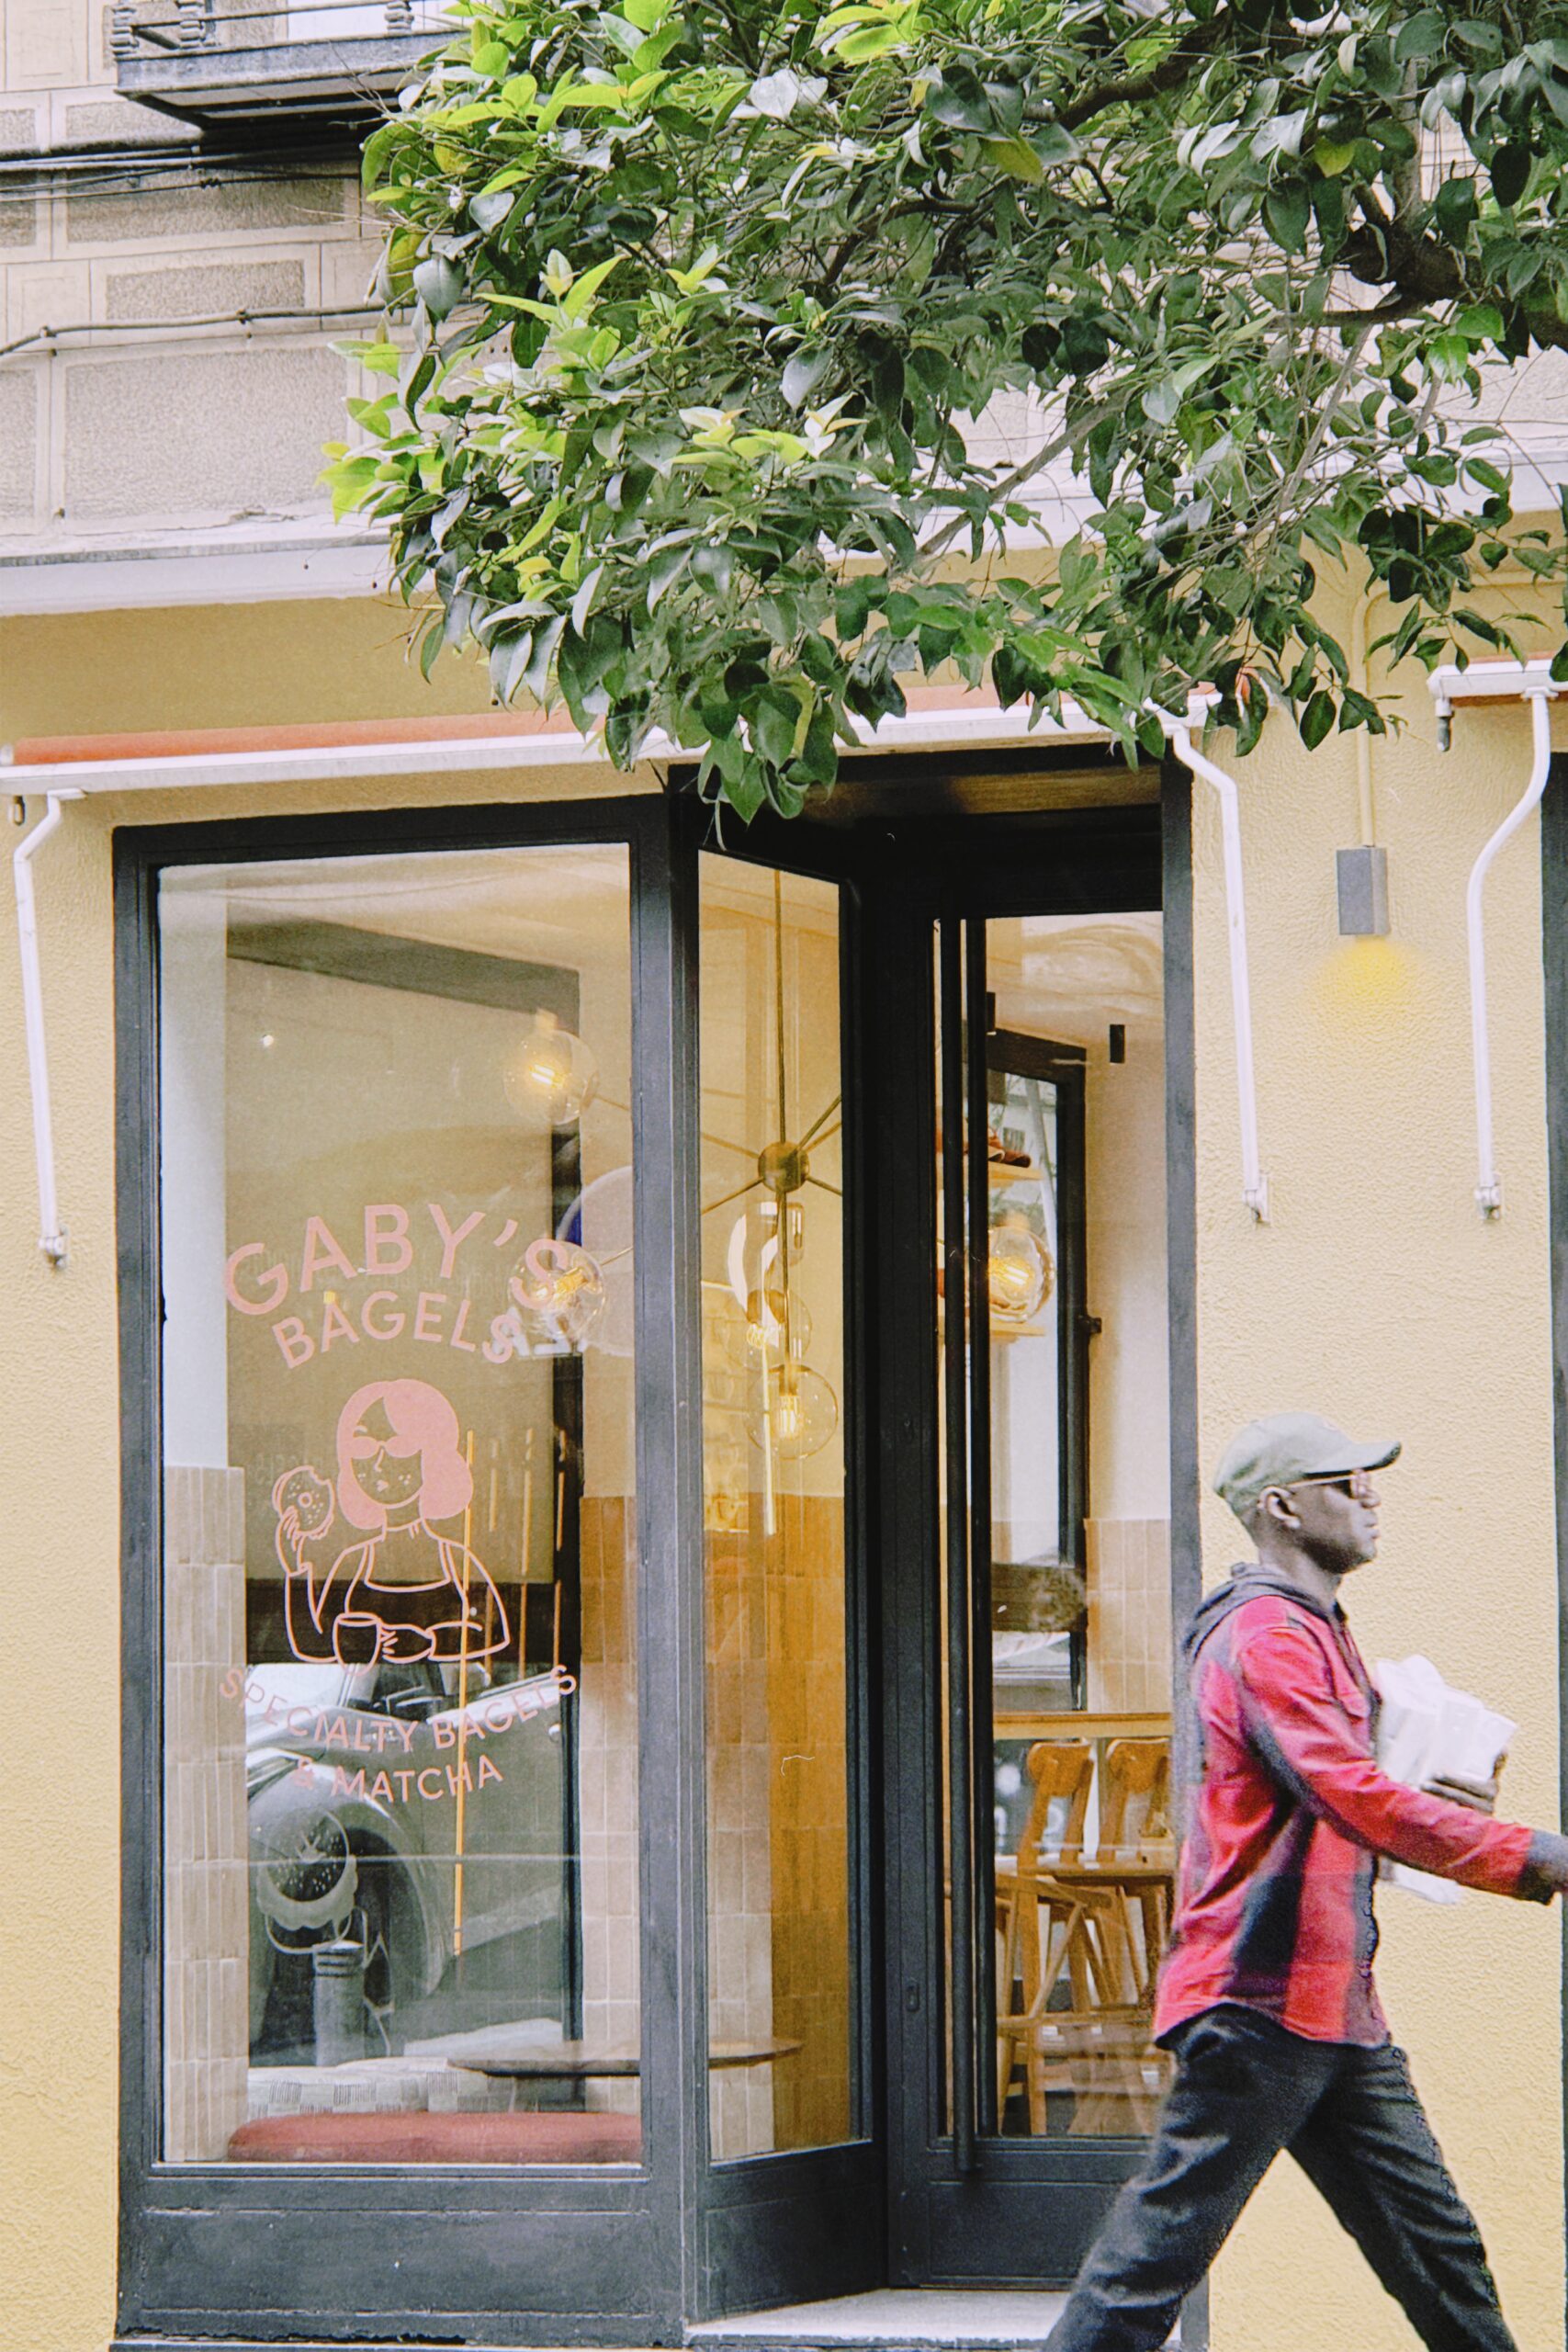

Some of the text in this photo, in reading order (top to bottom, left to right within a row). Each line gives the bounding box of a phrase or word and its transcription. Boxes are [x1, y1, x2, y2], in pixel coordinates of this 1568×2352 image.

[224, 1203, 570, 1315] GABY'S
[272, 1290, 522, 1369] BAGELS
[219, 1664, 577, 1754] SPECIALTY BAGELS
[291, 1753, 504, 1804] & MATCHA
